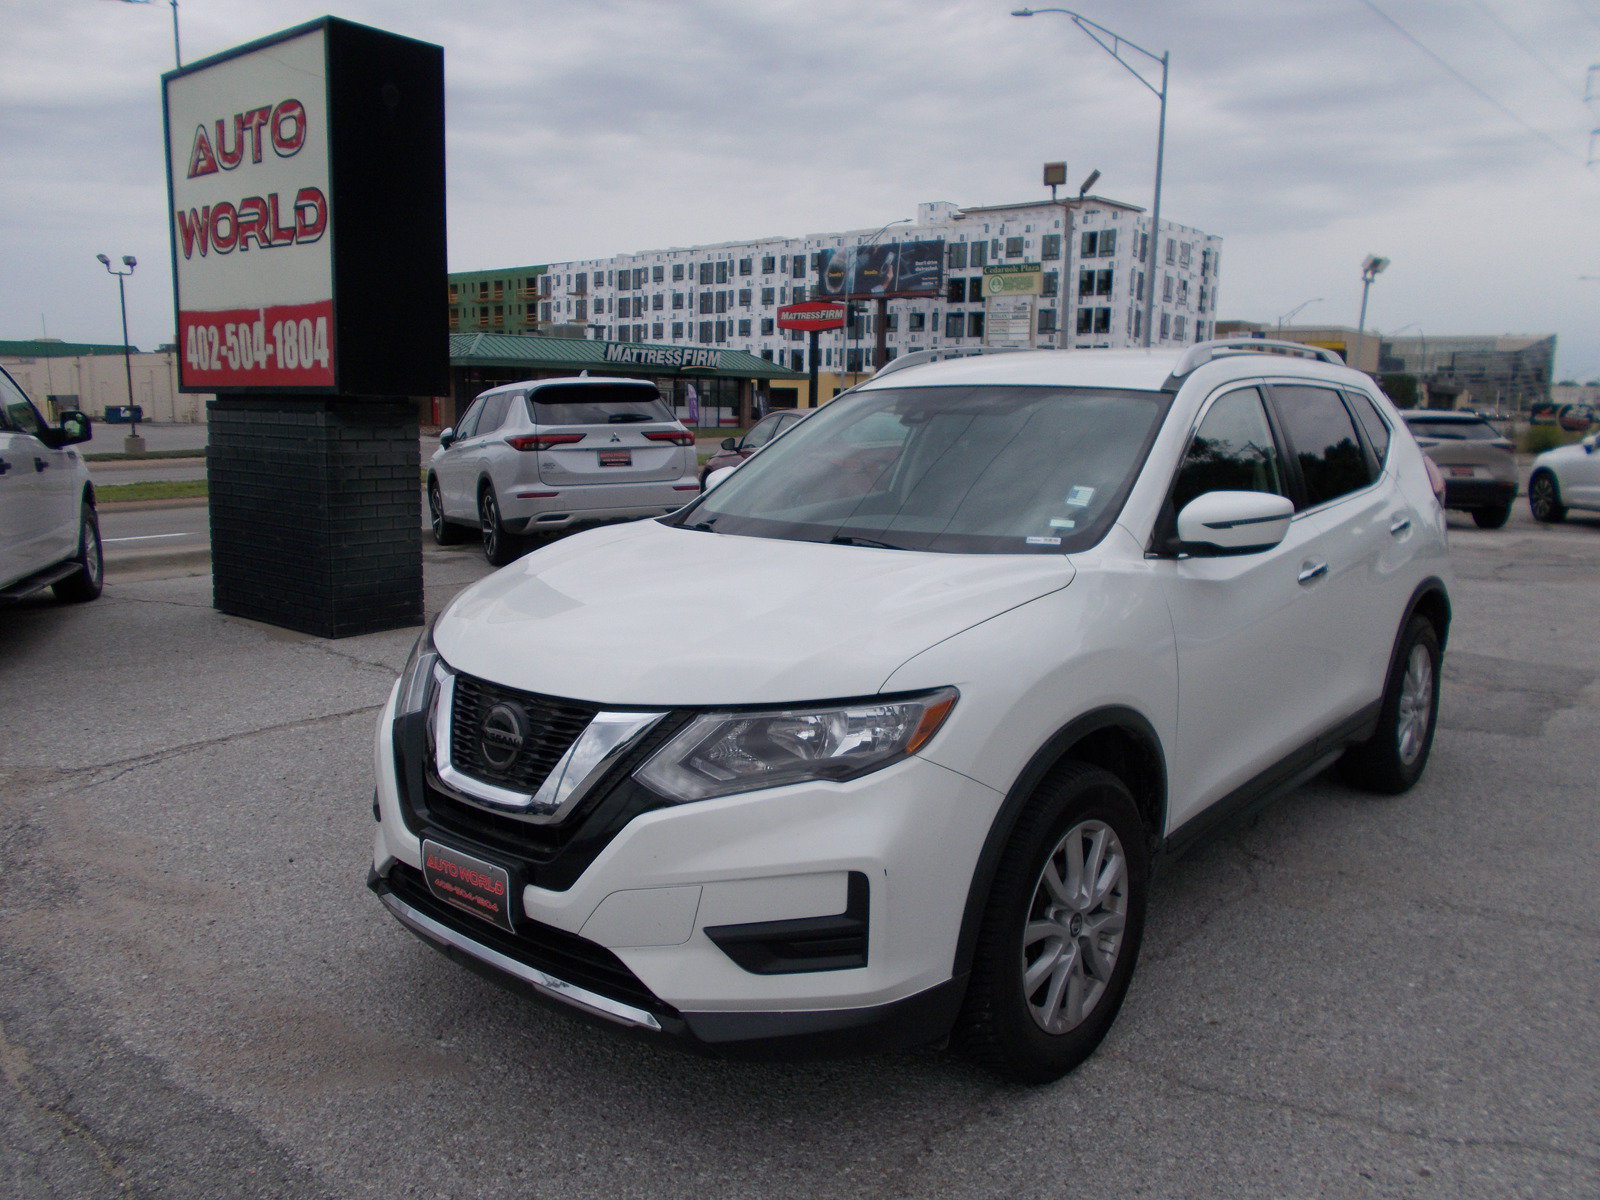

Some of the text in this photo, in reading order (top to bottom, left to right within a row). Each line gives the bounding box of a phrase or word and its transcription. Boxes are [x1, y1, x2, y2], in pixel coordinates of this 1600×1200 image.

[187, 98, 307, 179] AUTO
[177, 186, 328, 260] WORLD
[1021, 263, 1040, 272] Plaza
[186, 316, 330, 371] 402-504-1804
[426, 855, 504, 895] AUTO WORLD
